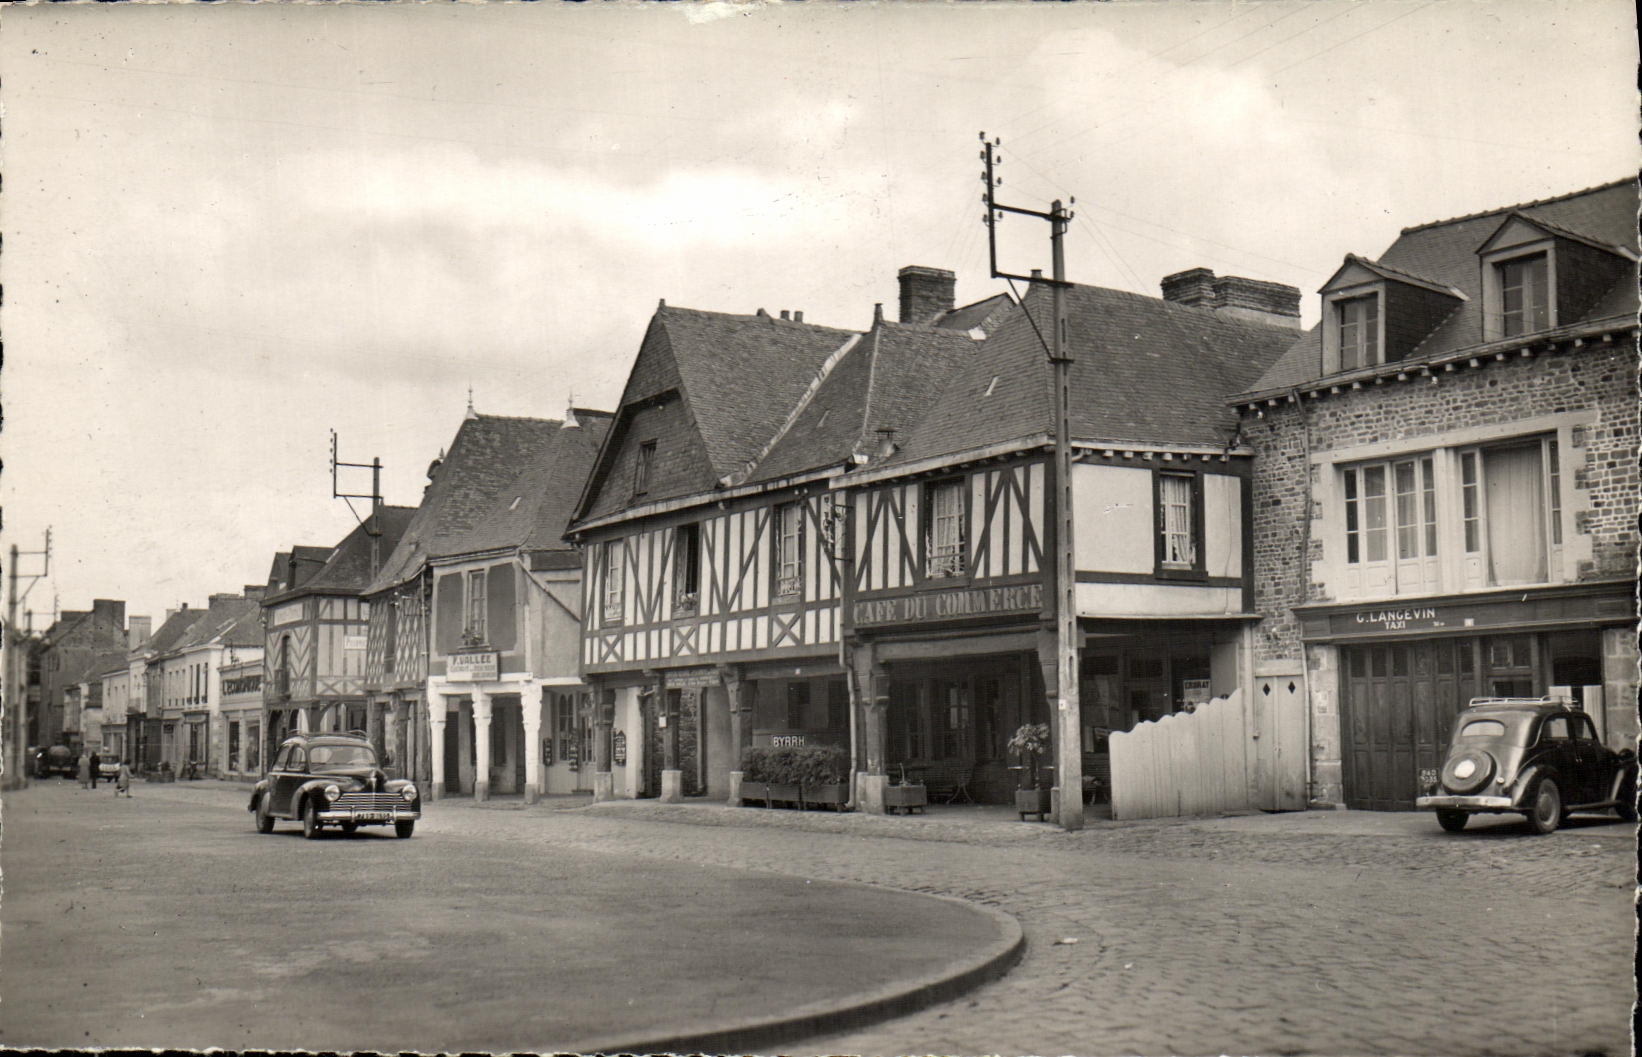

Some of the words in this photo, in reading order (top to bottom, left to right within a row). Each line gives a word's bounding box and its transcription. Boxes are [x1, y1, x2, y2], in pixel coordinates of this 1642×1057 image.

[904, 596, 927, 621] DU
[935, 584, 1042, 618] COMMERCE
[1385, 620, 1406, 630] TAXI
[773, 735, 805, 748] BYRRH
